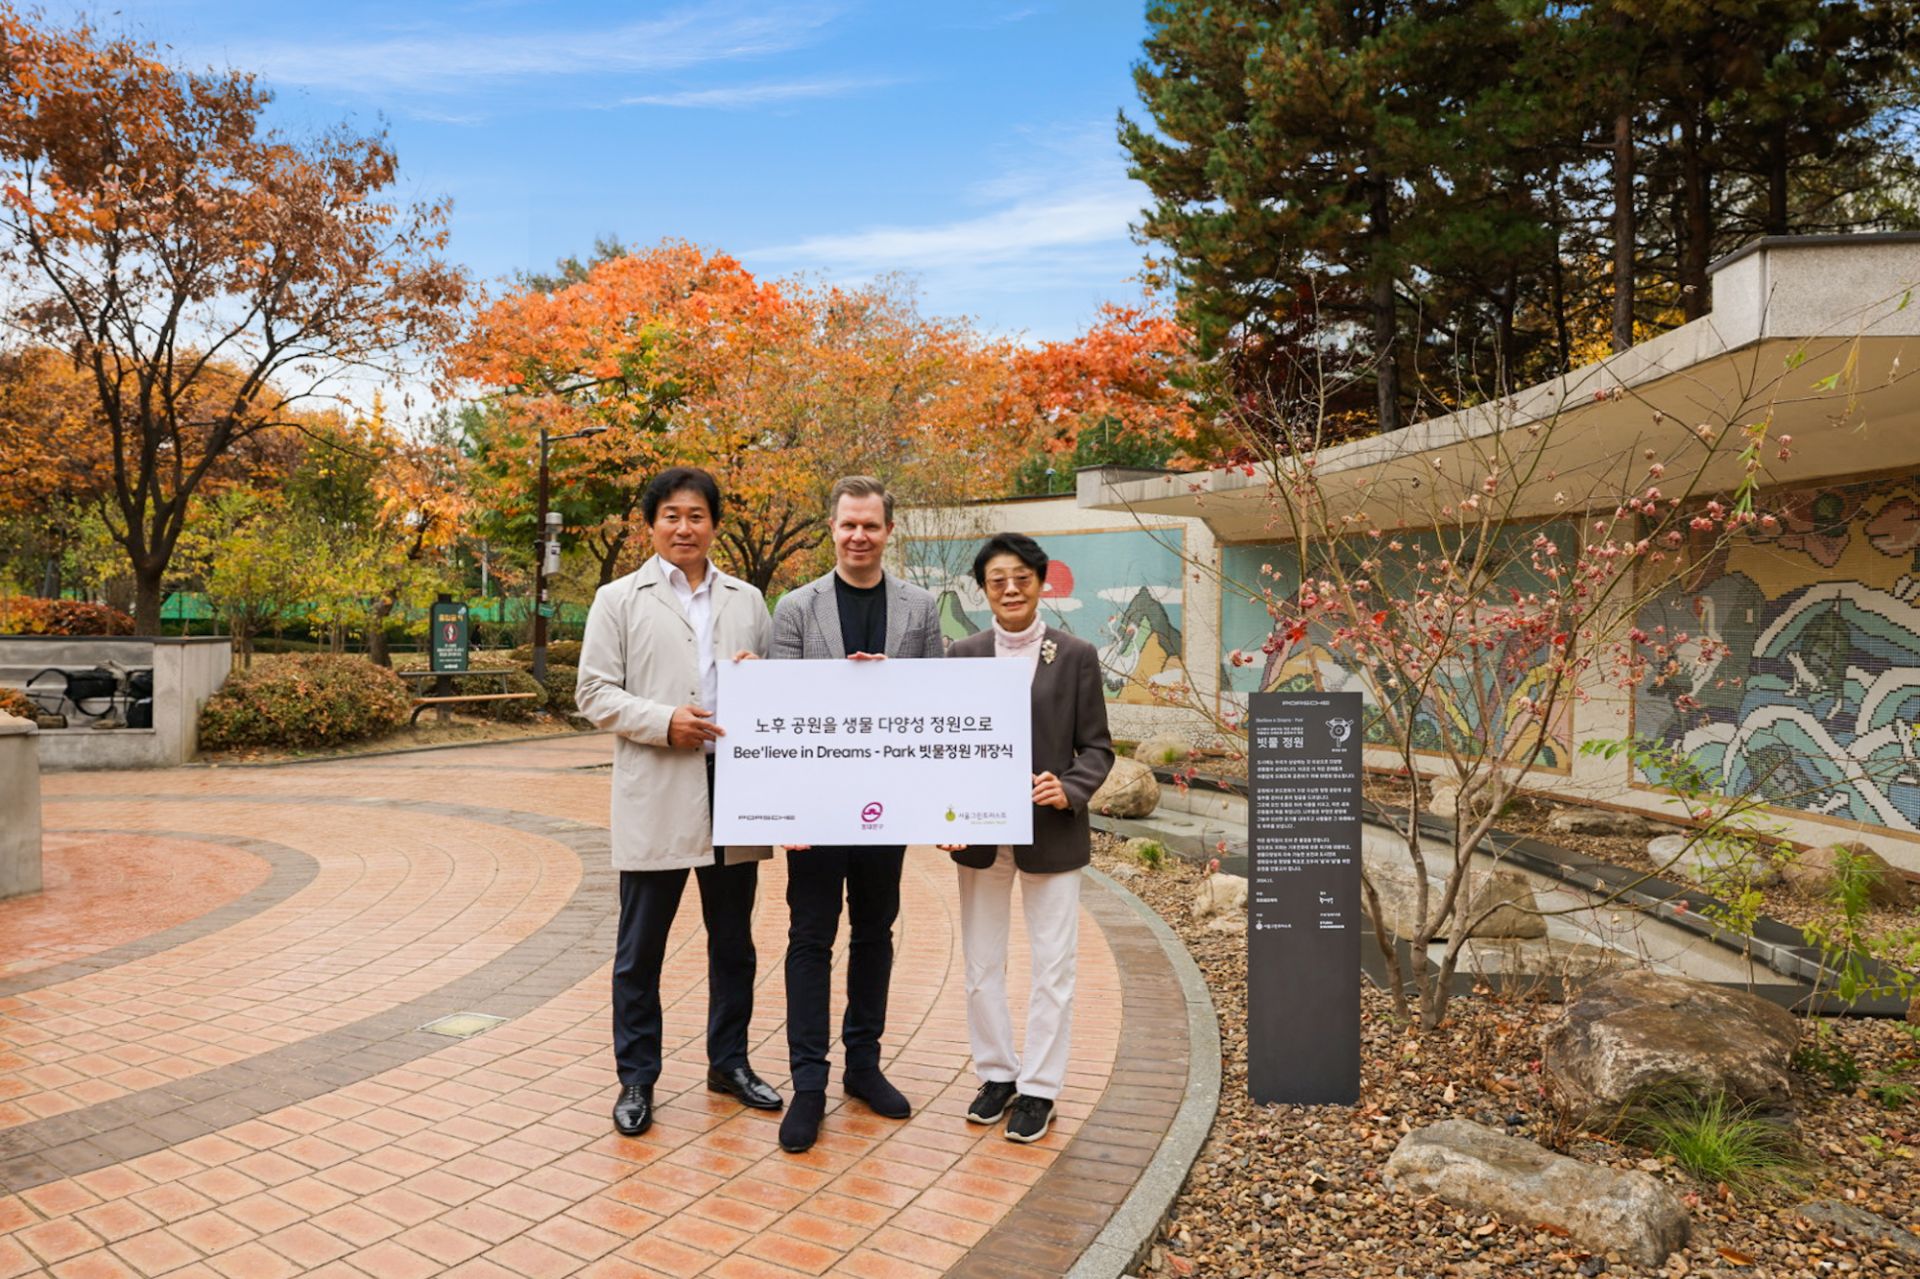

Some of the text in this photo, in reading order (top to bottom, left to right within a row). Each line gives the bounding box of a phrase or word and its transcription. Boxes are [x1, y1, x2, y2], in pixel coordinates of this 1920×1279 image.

[755, 716, 993, 734] 노후 공원을 생물 다양성 정원으로
[1257, 737, 1304, 749] 빗물 정원
[801, 746, 814, 758] in
[817, 746, 872, 758] Dreams
[884, 745, 916, 758] Park
[919, 744, 972, 759] 빗물정원
[974, 744, 1014, 759] 개장식
